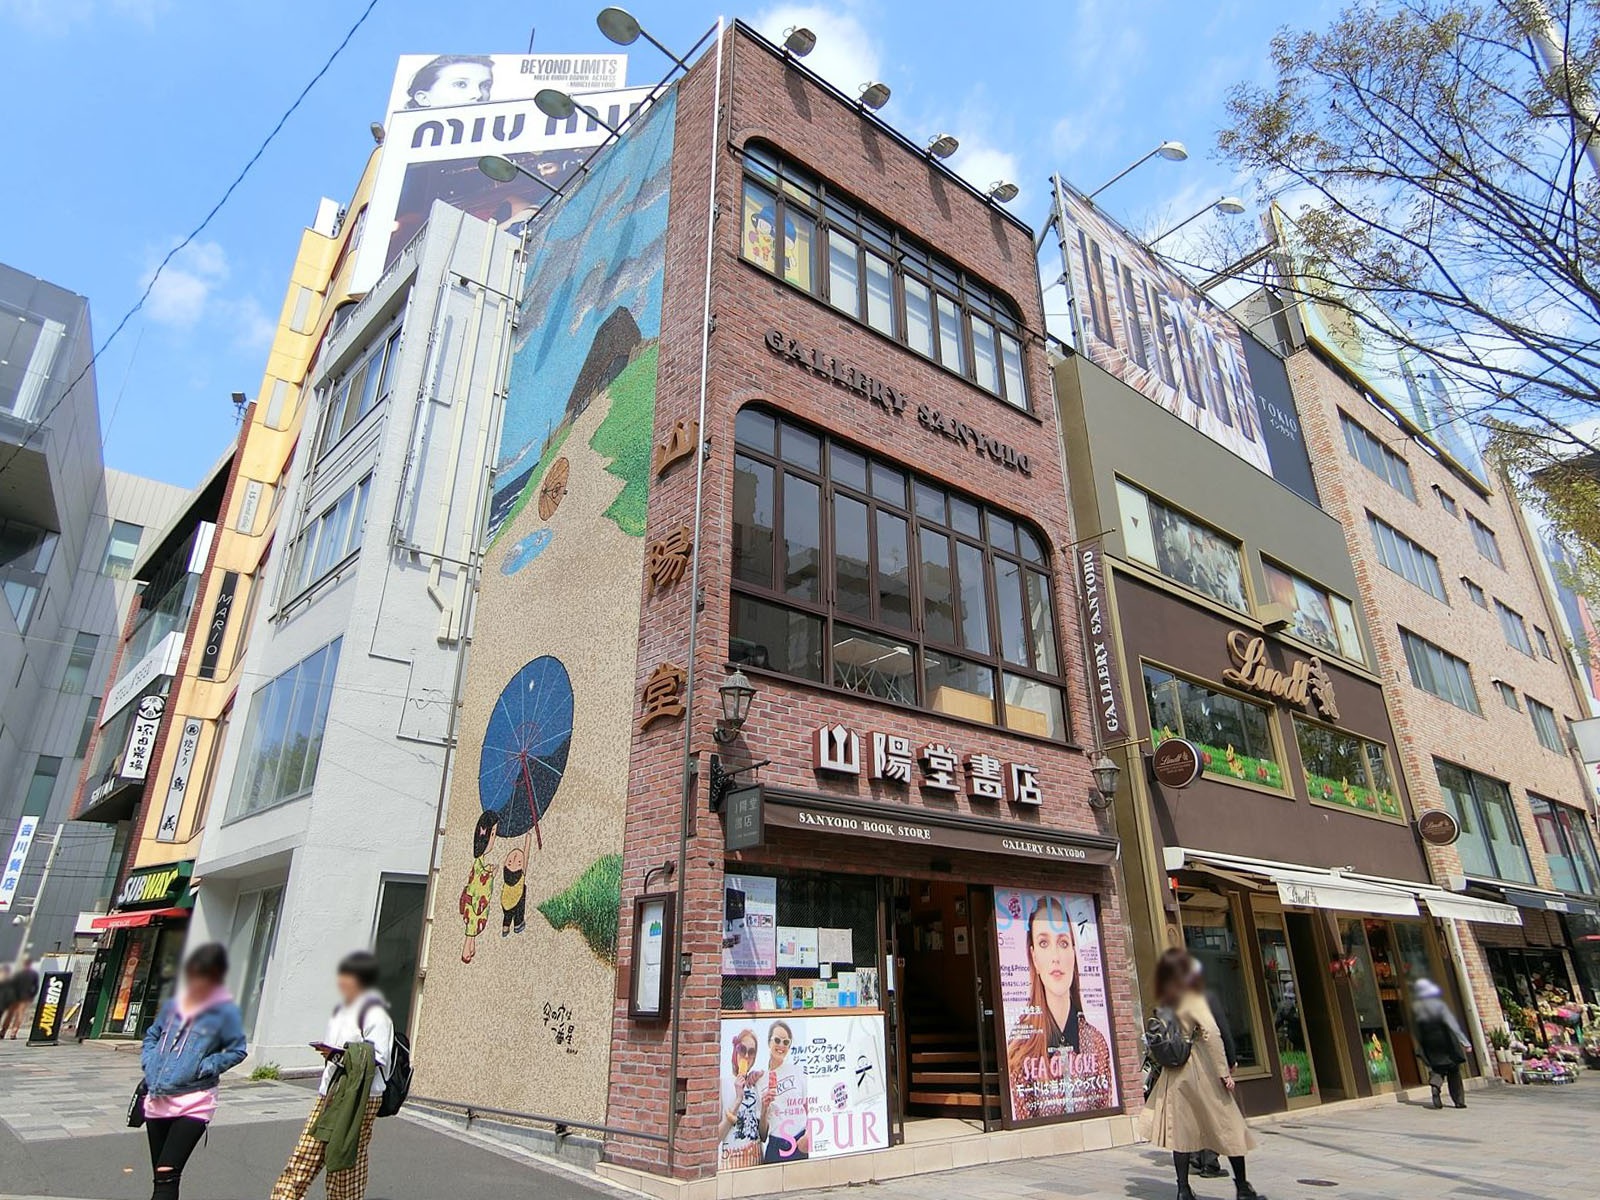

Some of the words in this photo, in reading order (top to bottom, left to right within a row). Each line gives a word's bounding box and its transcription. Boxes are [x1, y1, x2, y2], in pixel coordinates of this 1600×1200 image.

[520, 59, 572, 75] BEYOND
[573, 59, 618, 74] LIMITS
[764, 327, 908, 417] GALLERY
[916, 402, 1033, 477] SANYODO
[1259, 395, 1298, 433] TOKIO
[640, 419, 700, 731] 山陽堂
[1083, 550, 1102, 636] SANYODO
[206, 593, 233, 655] MARIO
[1094, 641, 1119, 733] GALLERY
[1223, 630, 1311, 706] Lindt
[813, 722, 1044, 807] 山陽堂書店
[798, 812, 858, 830] SANYODO
[861, 820, 895, 836] BOOK
[898, 825, 931, 840] STORE
[1002, 839, 1034, 855] GALLERY
[1036, 845, 1086, 859] SANYODO
[118, 867, 179, 903] SUBWAY
[39, 975, 63, 1038] SUBWAY
[1023, 1055, 1048, 1080] SEA
[1069, 1051, 1098, 1076] LOVE
[778, 1111, 881, 1158] SPUR
